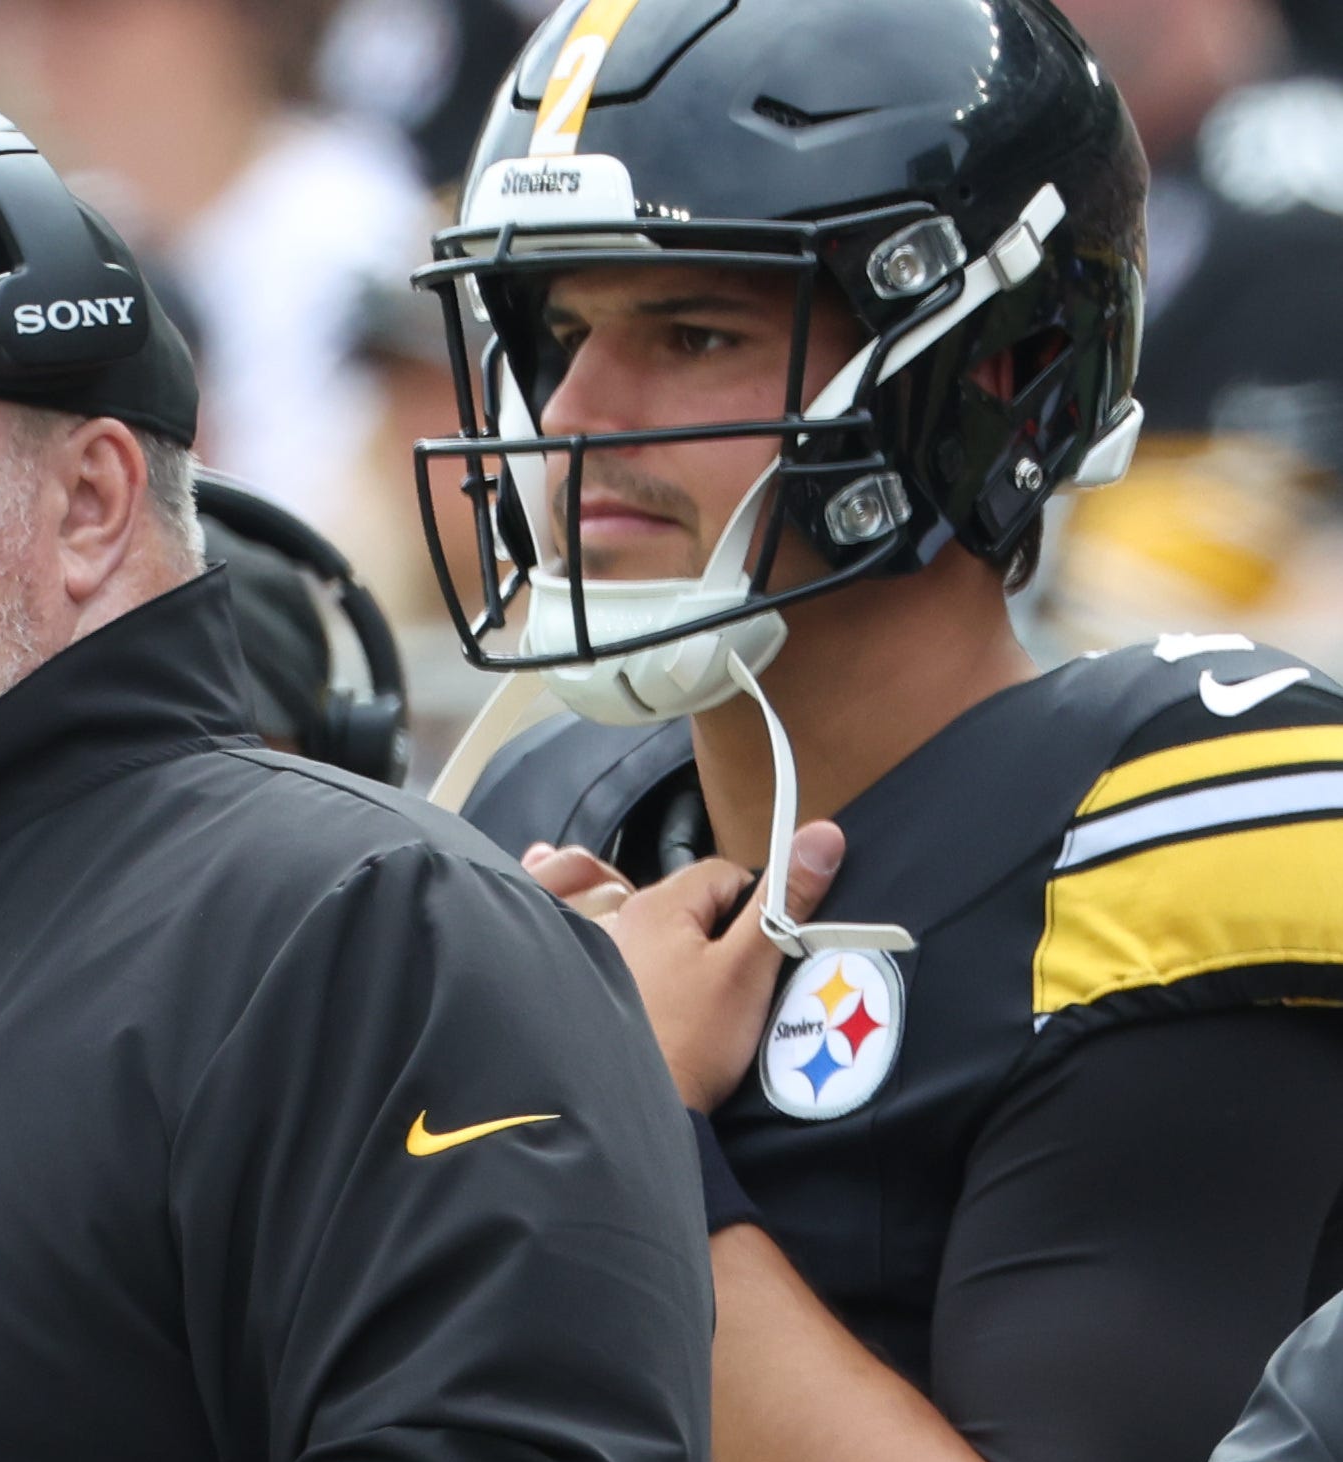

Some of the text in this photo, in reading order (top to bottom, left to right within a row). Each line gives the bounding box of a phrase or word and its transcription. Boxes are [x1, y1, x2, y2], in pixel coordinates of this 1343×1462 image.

[500, 163, 582, 195] Steelers
[14, 296, 135, 335] SONY
[775, 1016, 825, 1041] Steelers
